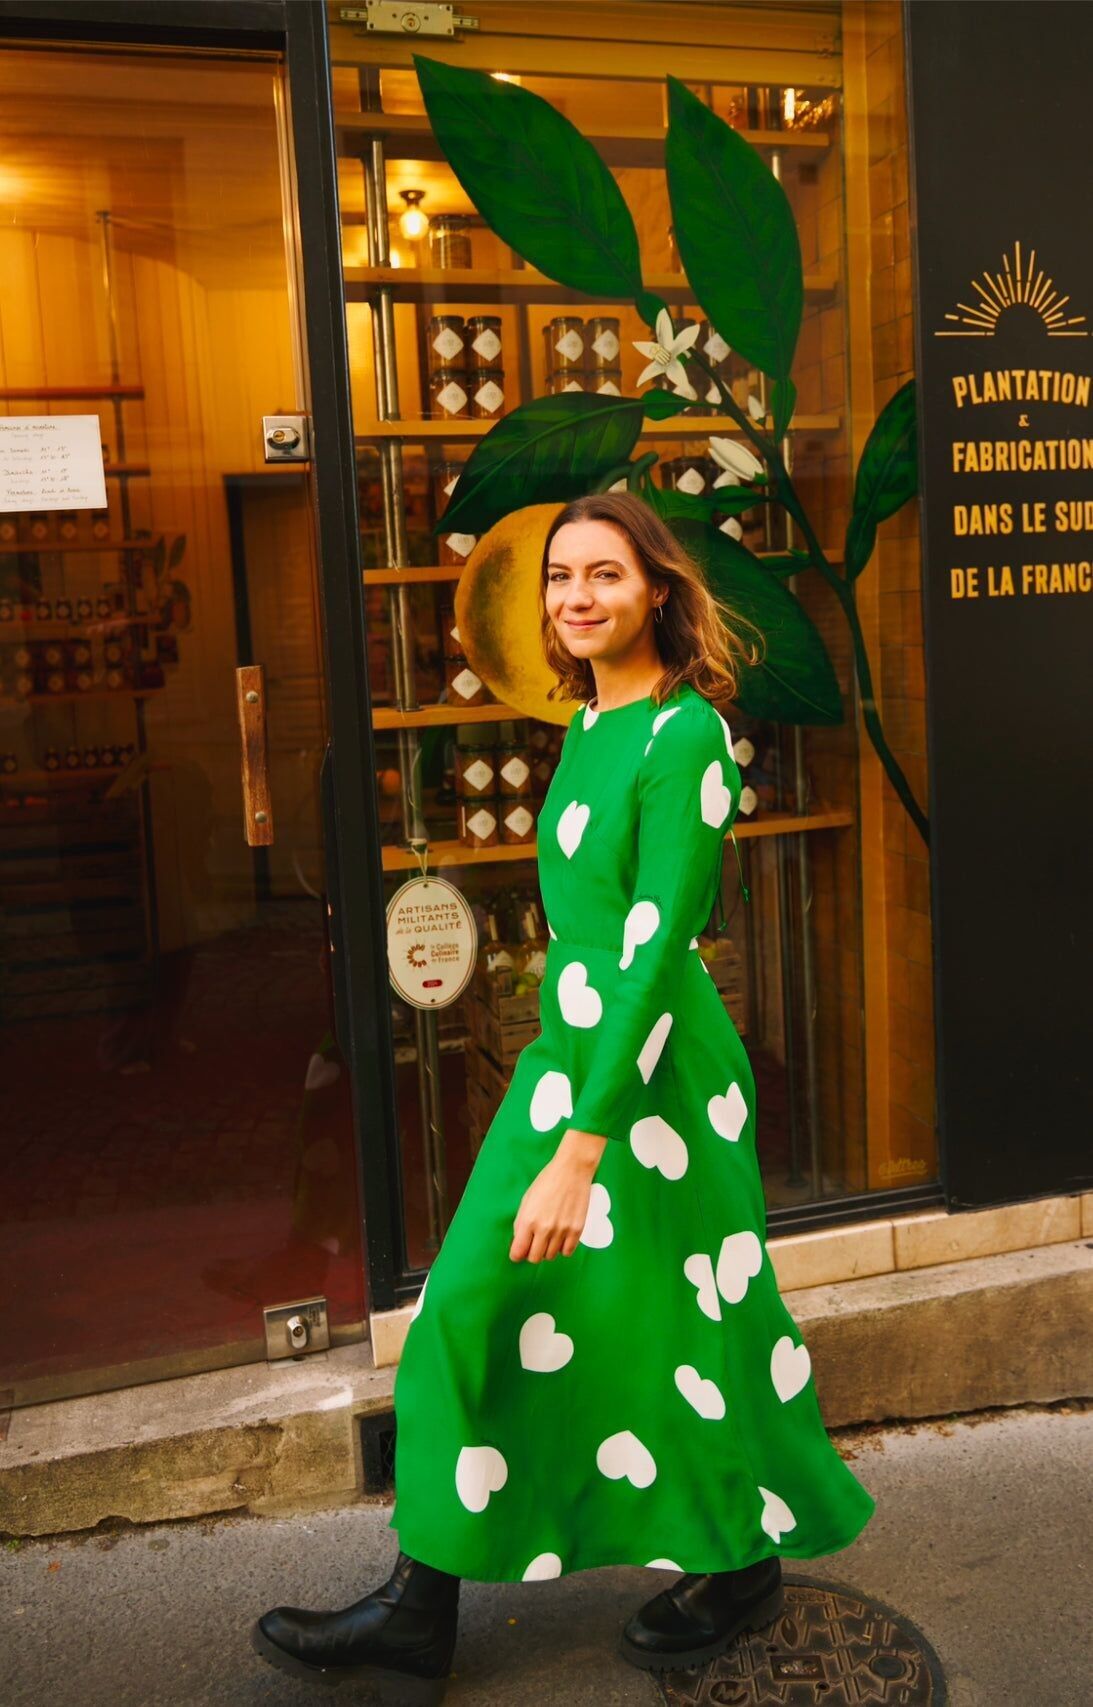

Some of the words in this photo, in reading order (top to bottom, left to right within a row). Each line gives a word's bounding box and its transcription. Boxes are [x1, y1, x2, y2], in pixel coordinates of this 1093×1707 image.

[951, 369, 1091, 408] PLANTATION
[1018, 414, 1030, 428] &
[952, 439, 1093, 472] FABRICATION
[953, 502, 1014, 536] DANS
[1021, 502, 1047, 533] LE
[1054, 500, 1093, 532] SUD
[950, 567, 979, 599] DE
[987, 565, 1015, 597] LA
[1021, 561, 1093, 595] FRANC
[397, 911, 460, 925] MILITANTS
[398, 902, 458, 915] ARTISANS
[414, 921, 463, 933] QUALITÉ
